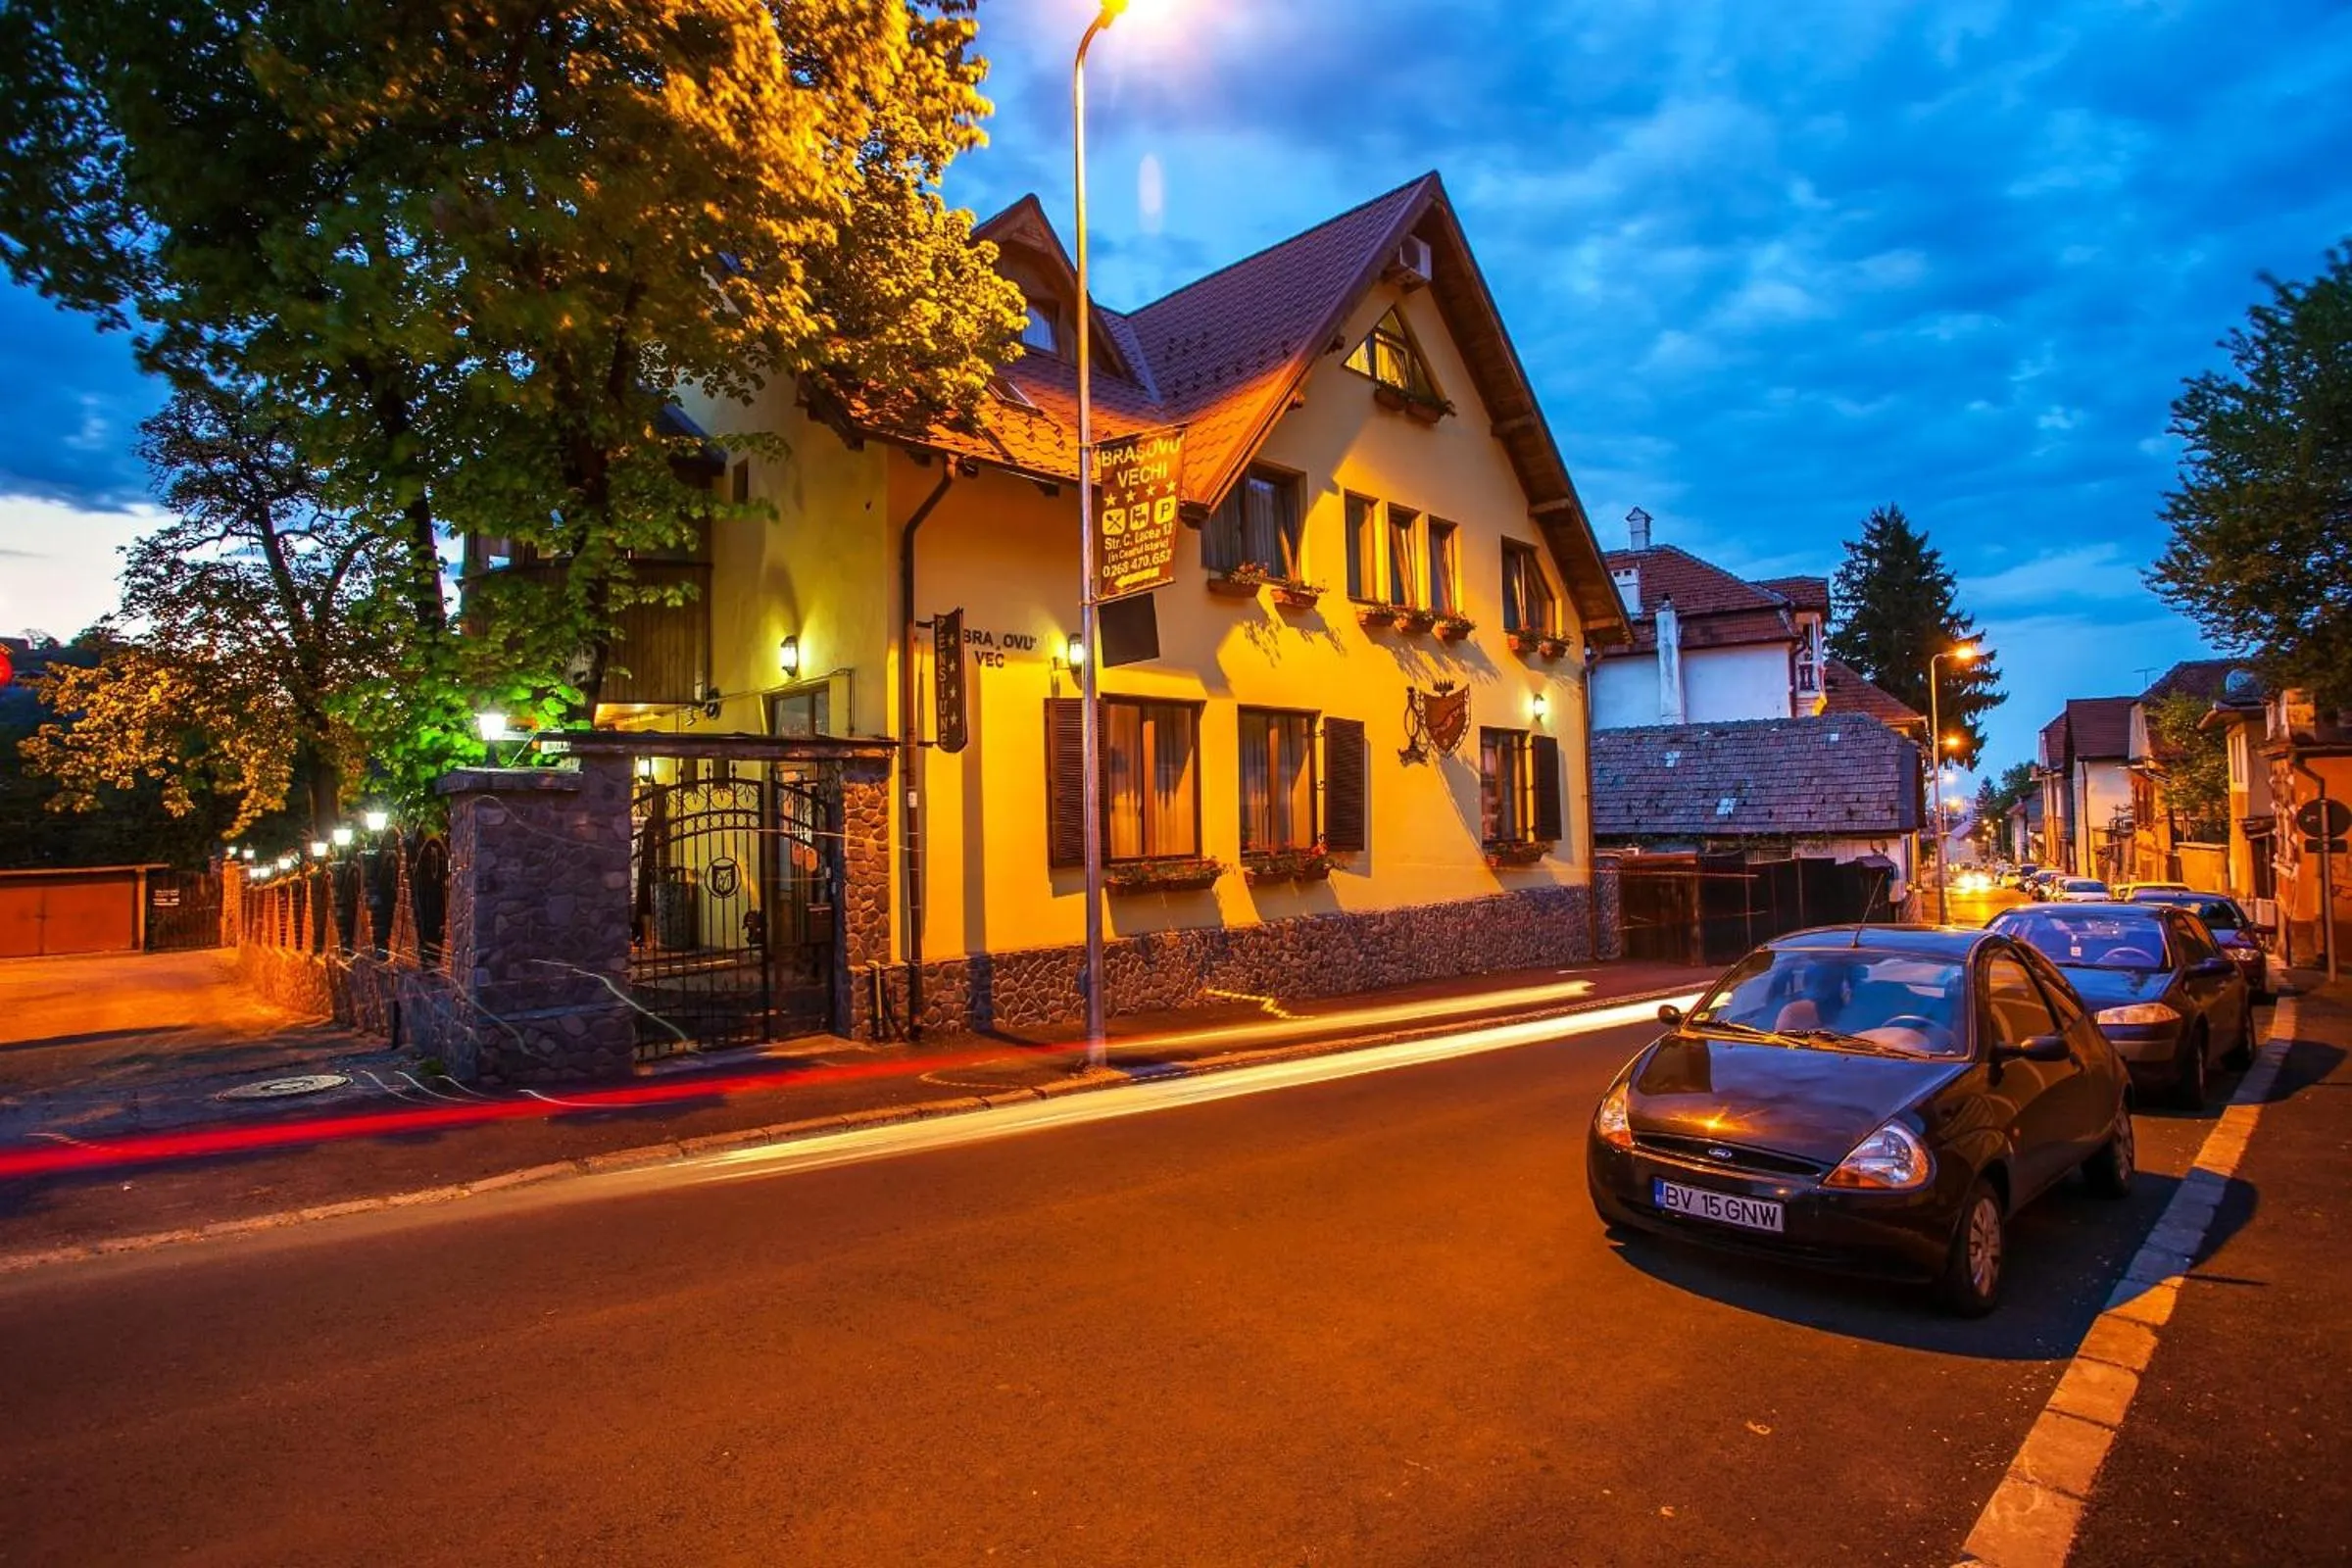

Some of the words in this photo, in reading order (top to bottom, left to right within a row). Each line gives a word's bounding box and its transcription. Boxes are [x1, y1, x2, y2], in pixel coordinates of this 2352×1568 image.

[1117, 461, 1167, 488] VECHI
[1104, 536, 1122, 551] Str.
[938, 616, 949, 748] PENSIUNE
[1666, 1186, 1692, 1209] BV
[1701, 1194, 1721, 1216] 15
[1726, 1200, 1777, 1227] GNW
